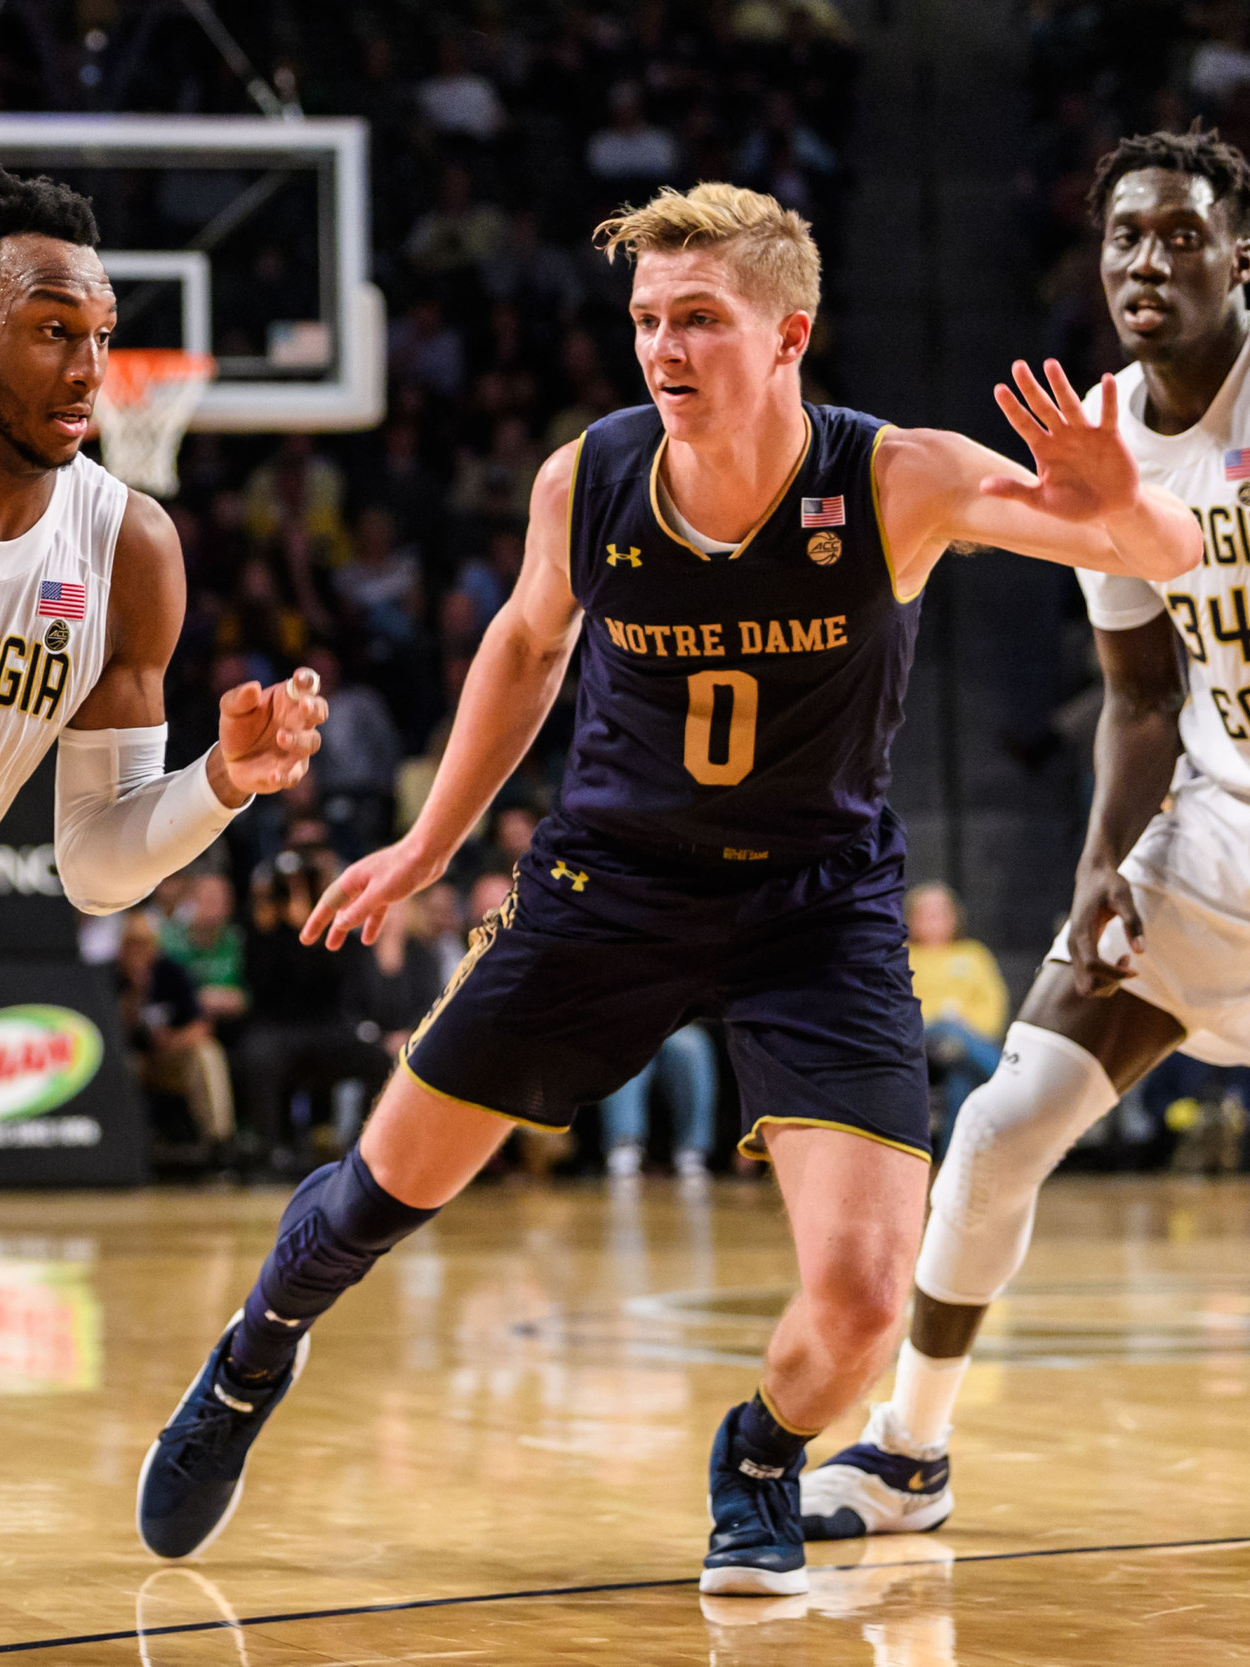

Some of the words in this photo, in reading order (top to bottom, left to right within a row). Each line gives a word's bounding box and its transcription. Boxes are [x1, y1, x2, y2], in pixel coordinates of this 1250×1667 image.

[605, 617, 726, 656] NOTRE
[738, 615, 848, 654] DAME
[1167, 587, 1250, 664] 34
[684, 670, 758, 786] 0
